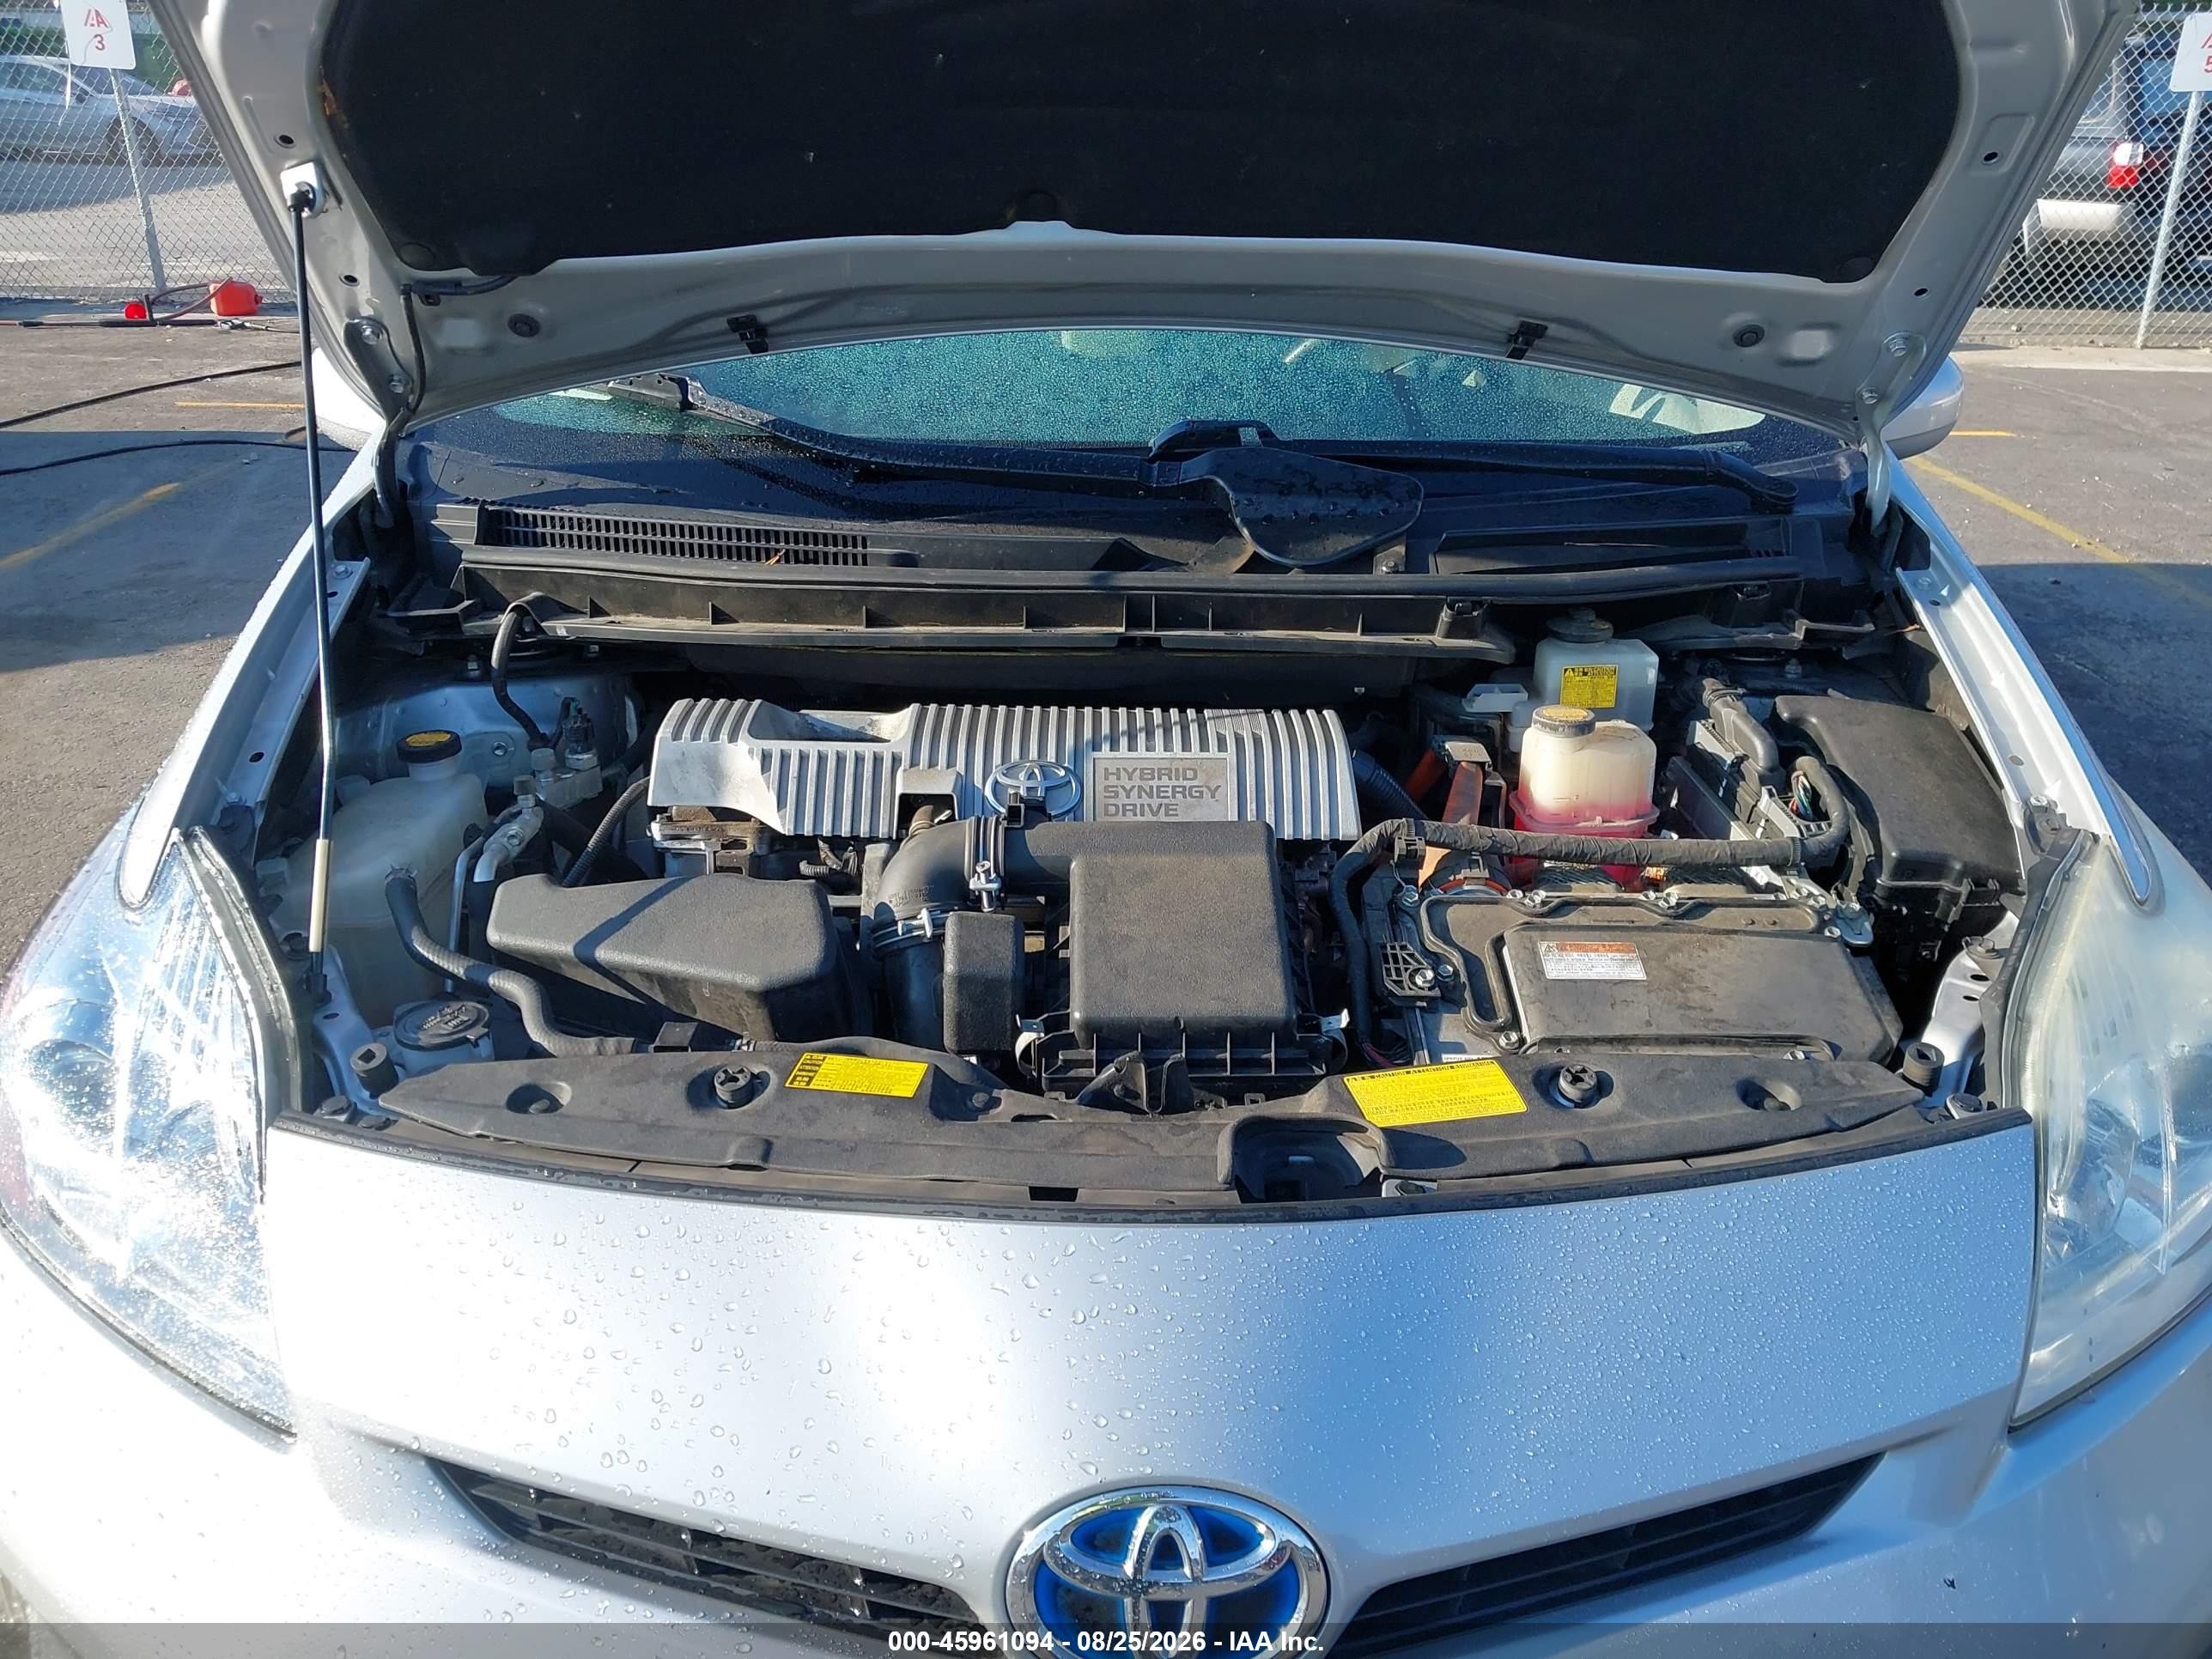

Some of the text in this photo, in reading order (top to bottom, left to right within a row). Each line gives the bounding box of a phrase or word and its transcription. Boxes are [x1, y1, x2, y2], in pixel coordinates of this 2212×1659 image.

[94, 33, 106, 51] 3
[1103, 767, 1198, 781] HYBRID
[1103, 785, 1221, 799] SYNERGY
[1103, 803, 1179, 817] DRIVE
